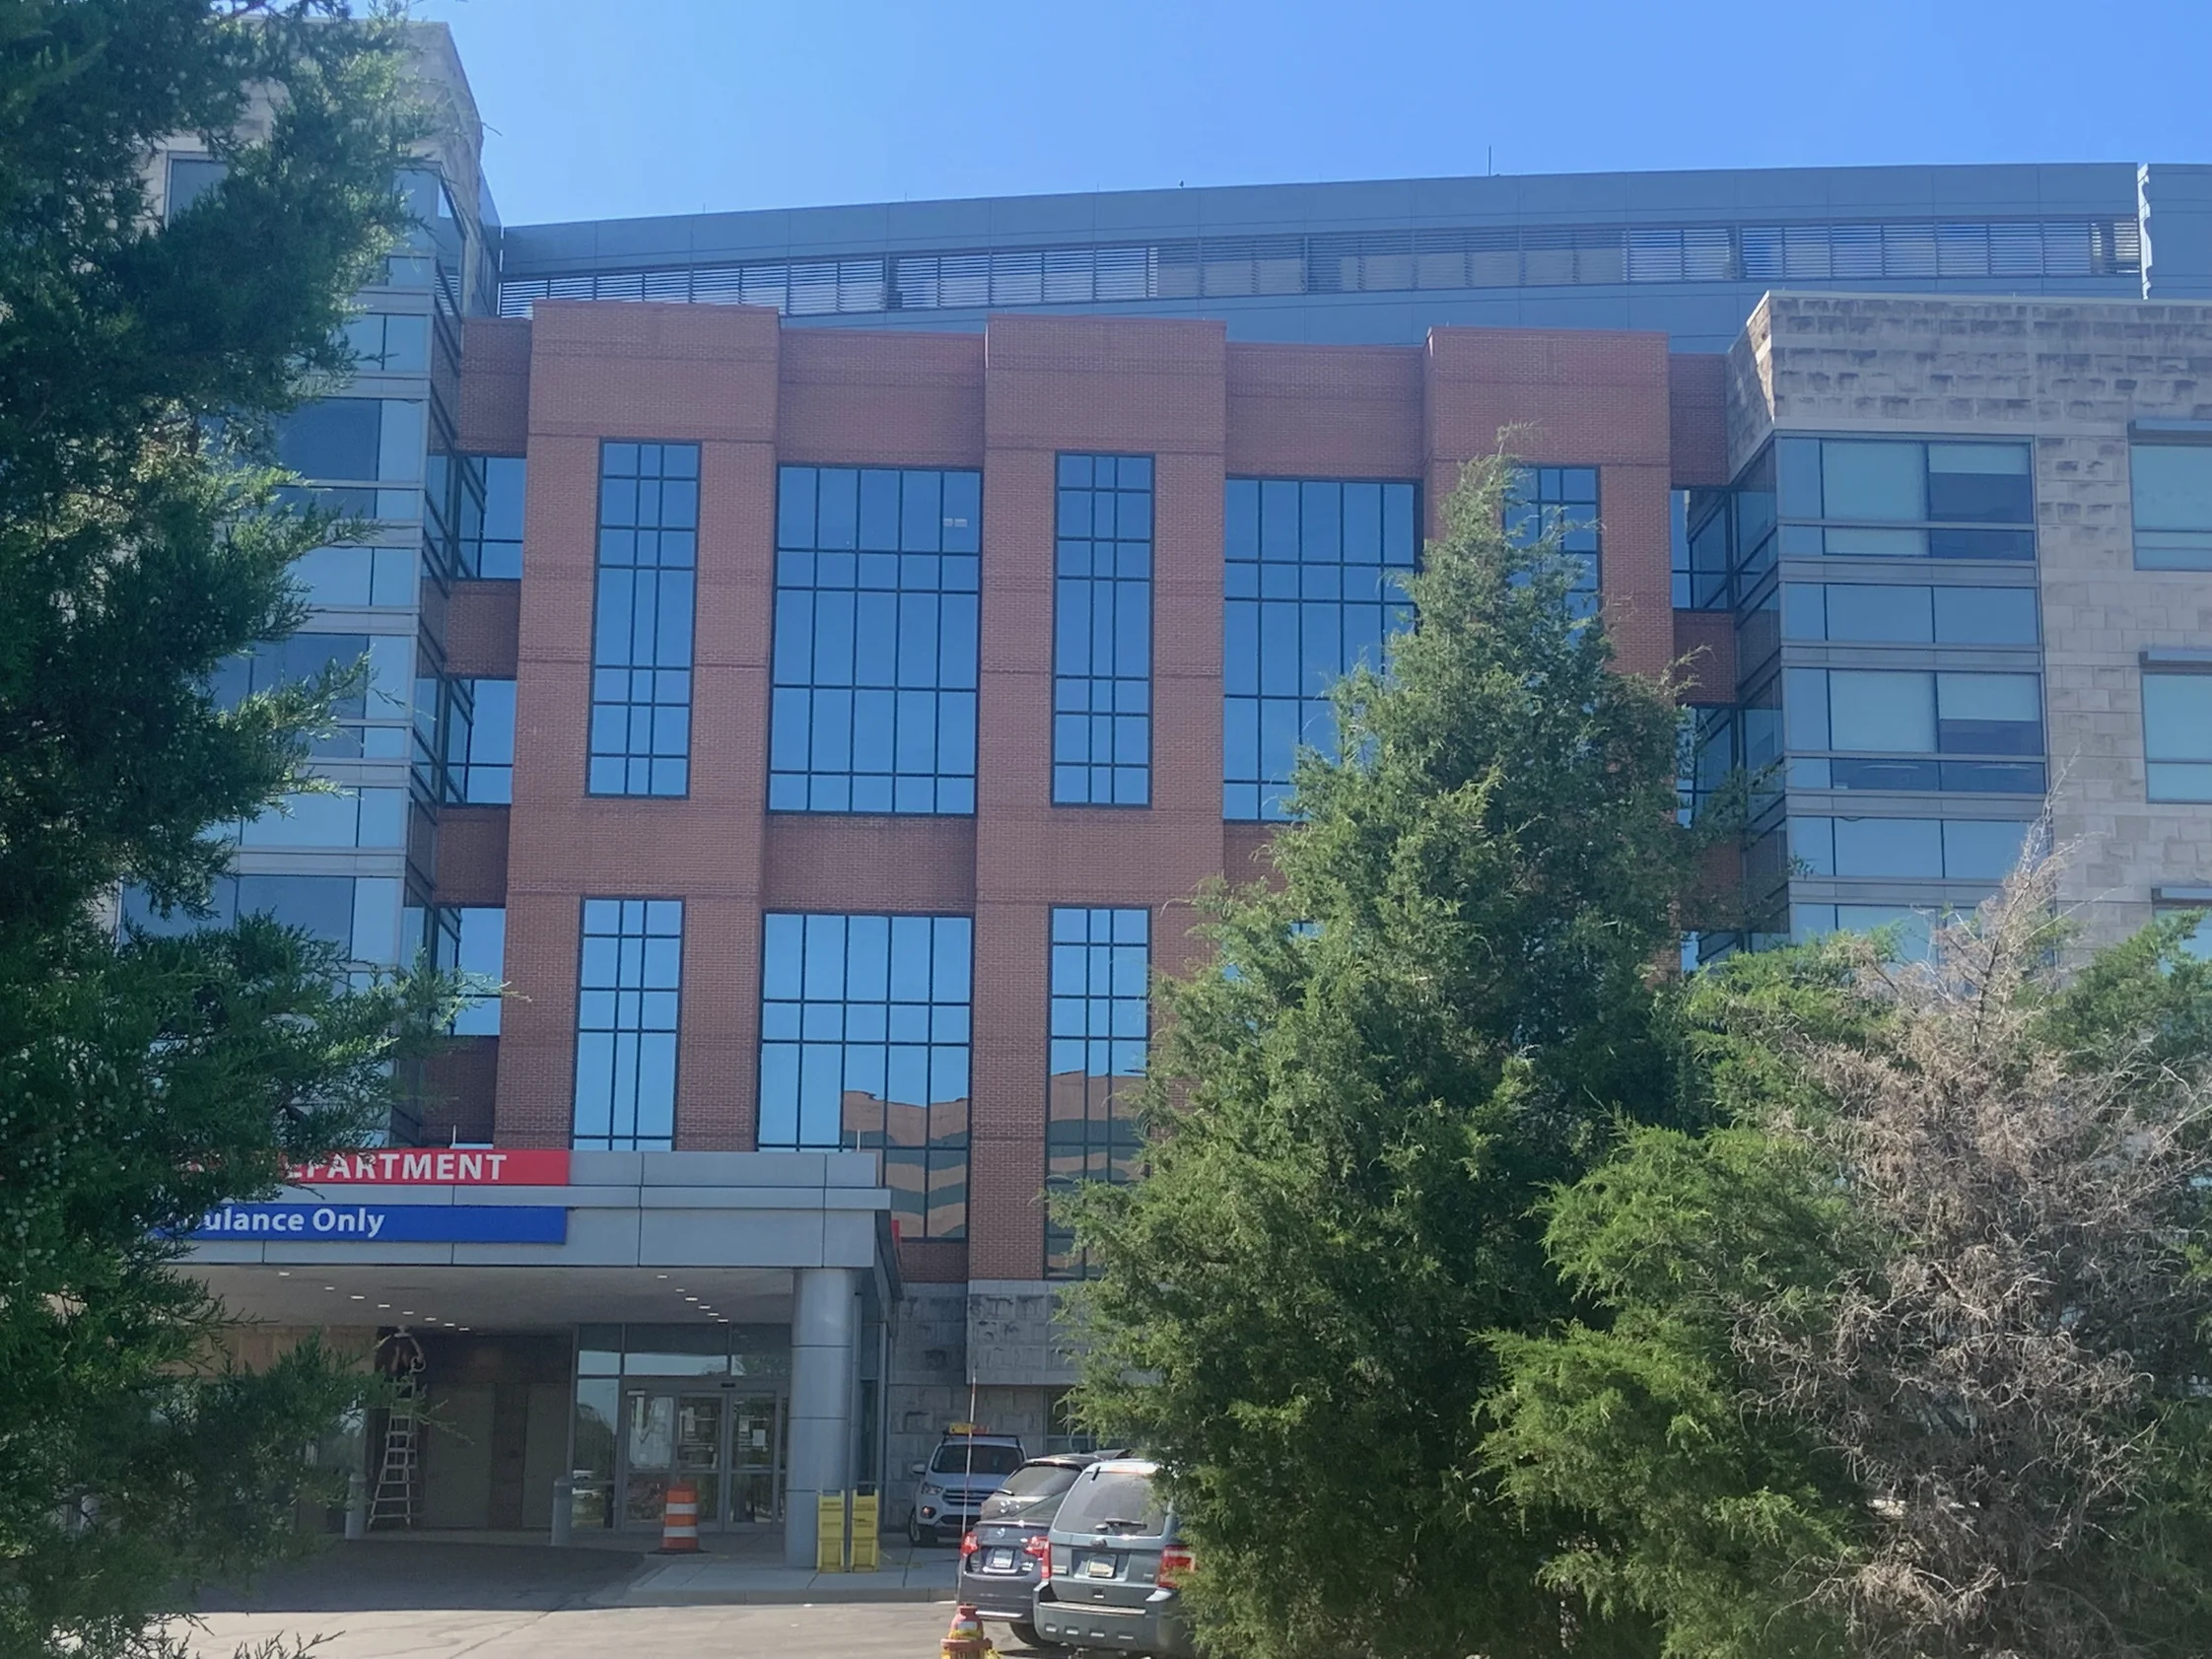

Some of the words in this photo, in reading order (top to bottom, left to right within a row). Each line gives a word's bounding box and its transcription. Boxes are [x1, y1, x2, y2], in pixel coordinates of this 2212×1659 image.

[283, 1151, 508, 1181] EPARTMENT
[202, 1206, 304, 1230] ulance
[312, 1208, 385, 1238] Only
